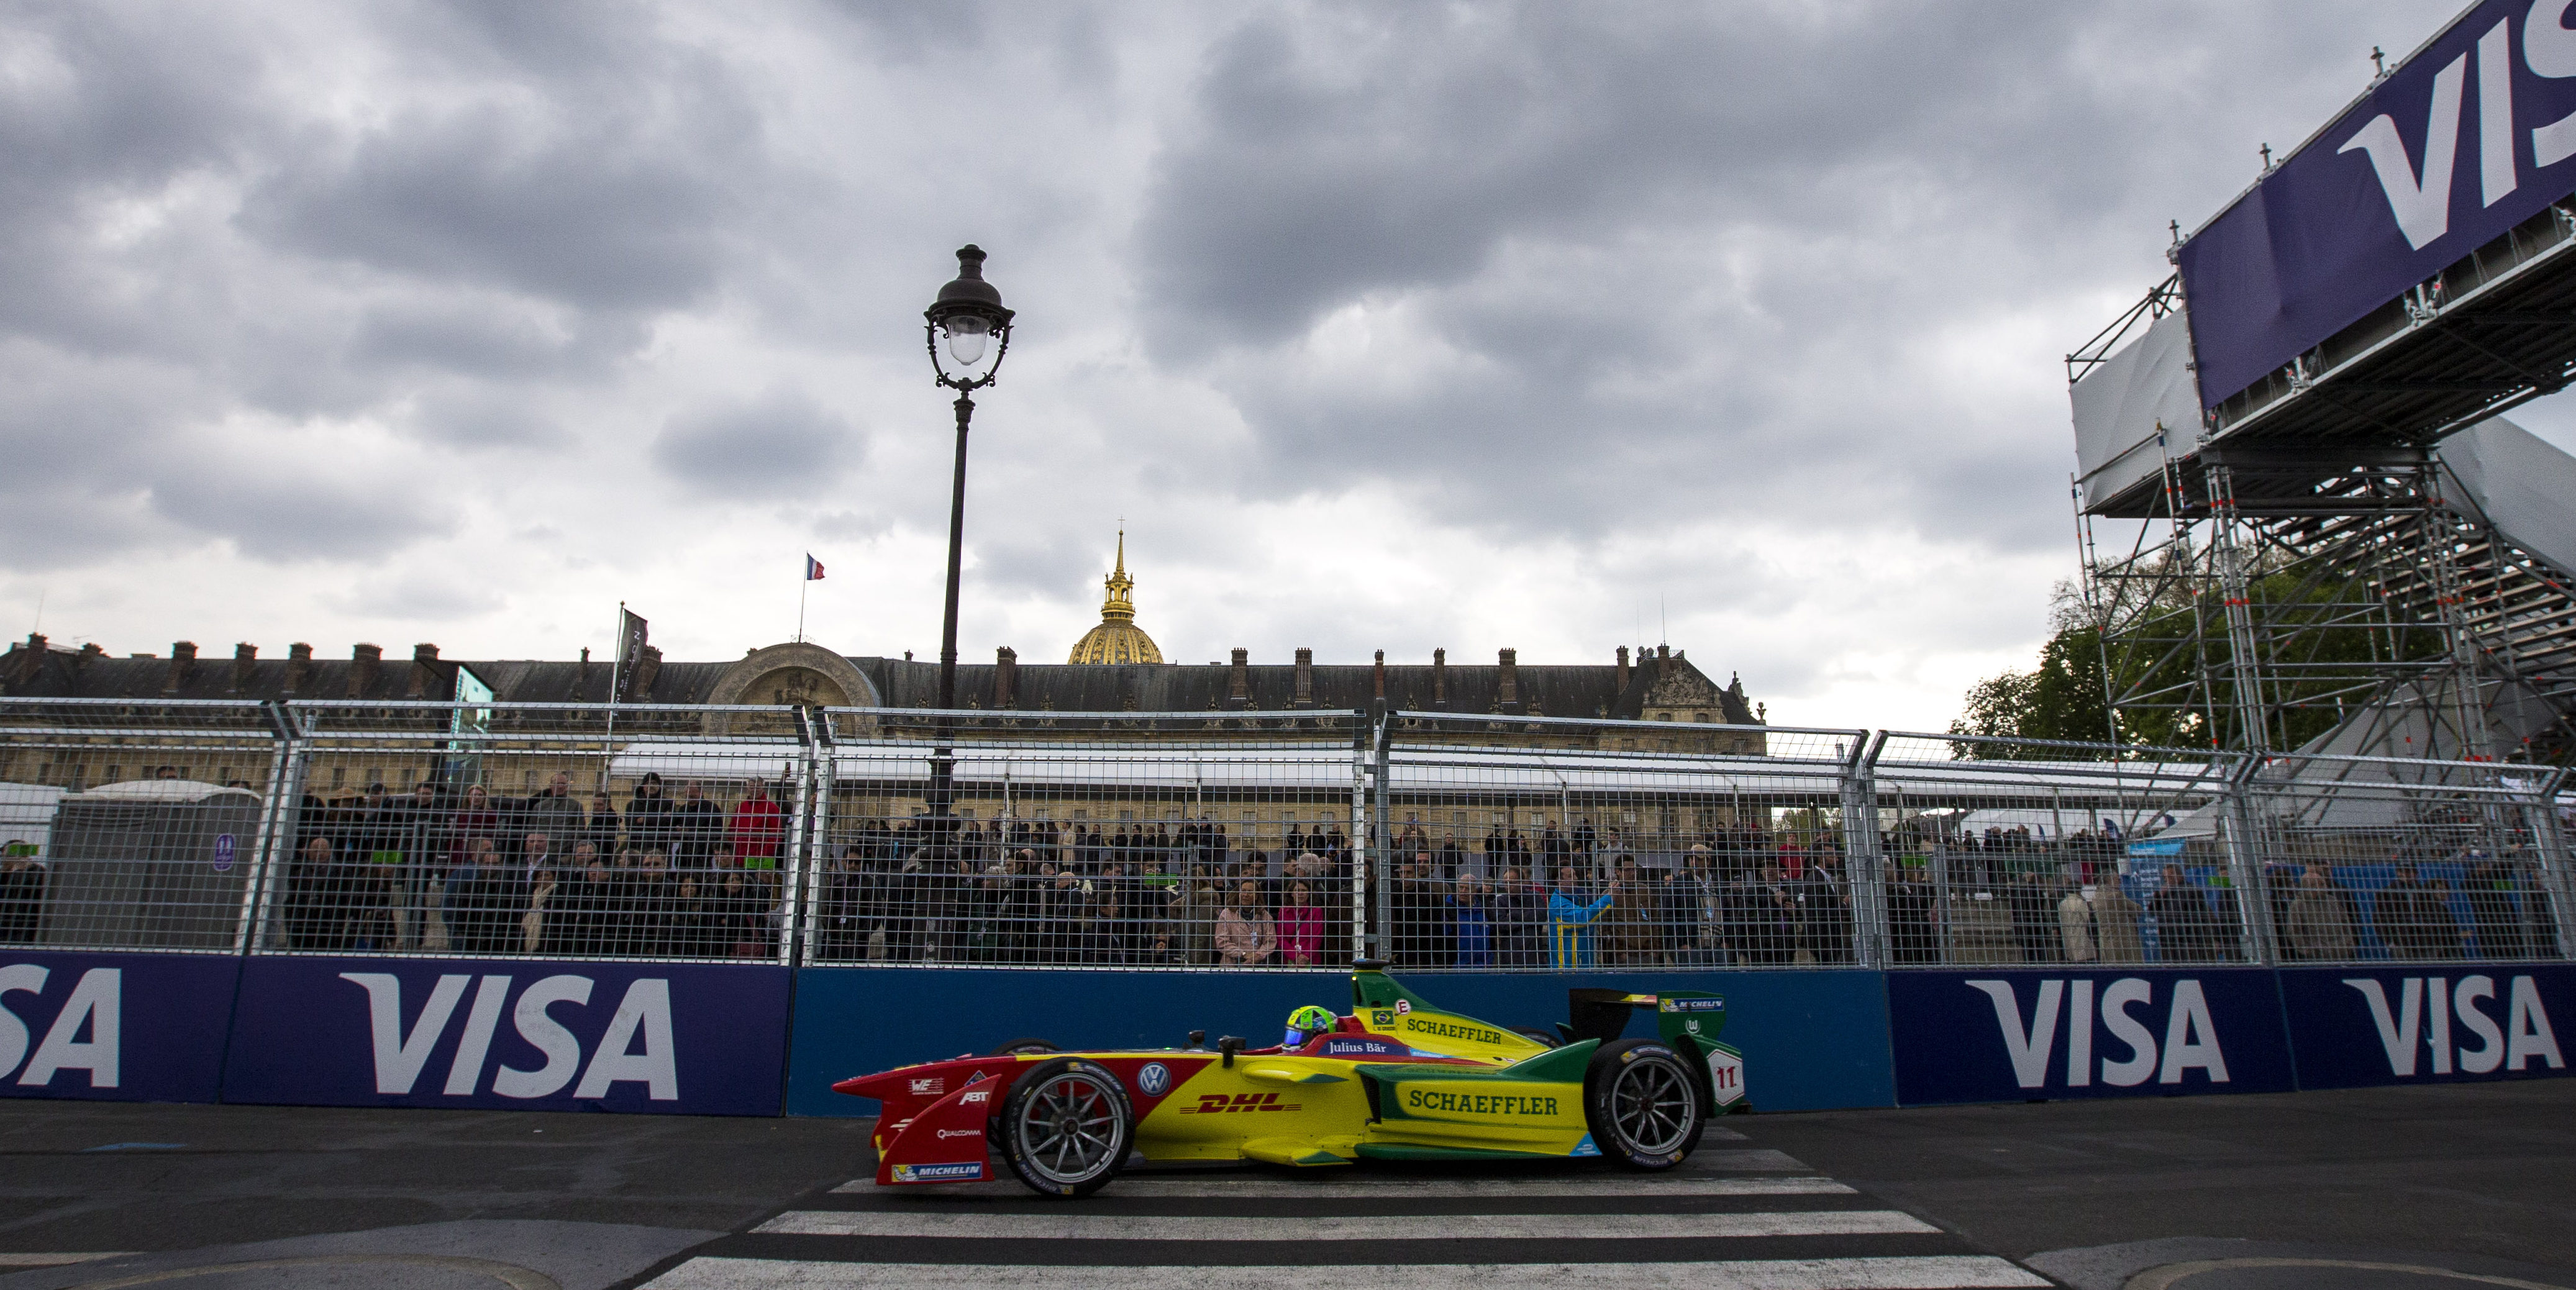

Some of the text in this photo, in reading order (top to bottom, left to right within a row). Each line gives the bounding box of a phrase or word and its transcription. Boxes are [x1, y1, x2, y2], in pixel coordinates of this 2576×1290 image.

[1398, 1001, 1408, 1013] E
[1407, 1018, 1501, 1045] SCHAEFFLER
[1965, 978, 2230, 1088] VISA
[2342, 974, 2565, 1076] VISA
[339, 973, 678, 1101] VISA
[1329, 1042, 1387, 1054] Julius Bär
[1717, 1066, 1736, 1089] 11
[958, 1091, 990, 1106] ABT
[1196, 1092, 1285, 1114] DHL
[1409, 1089, 1559, 1115] SCHAEFFLER
[937, 1129, 981, 1140] QUALCOMM
[918, 1165, 980, 1176] MICHELIN
